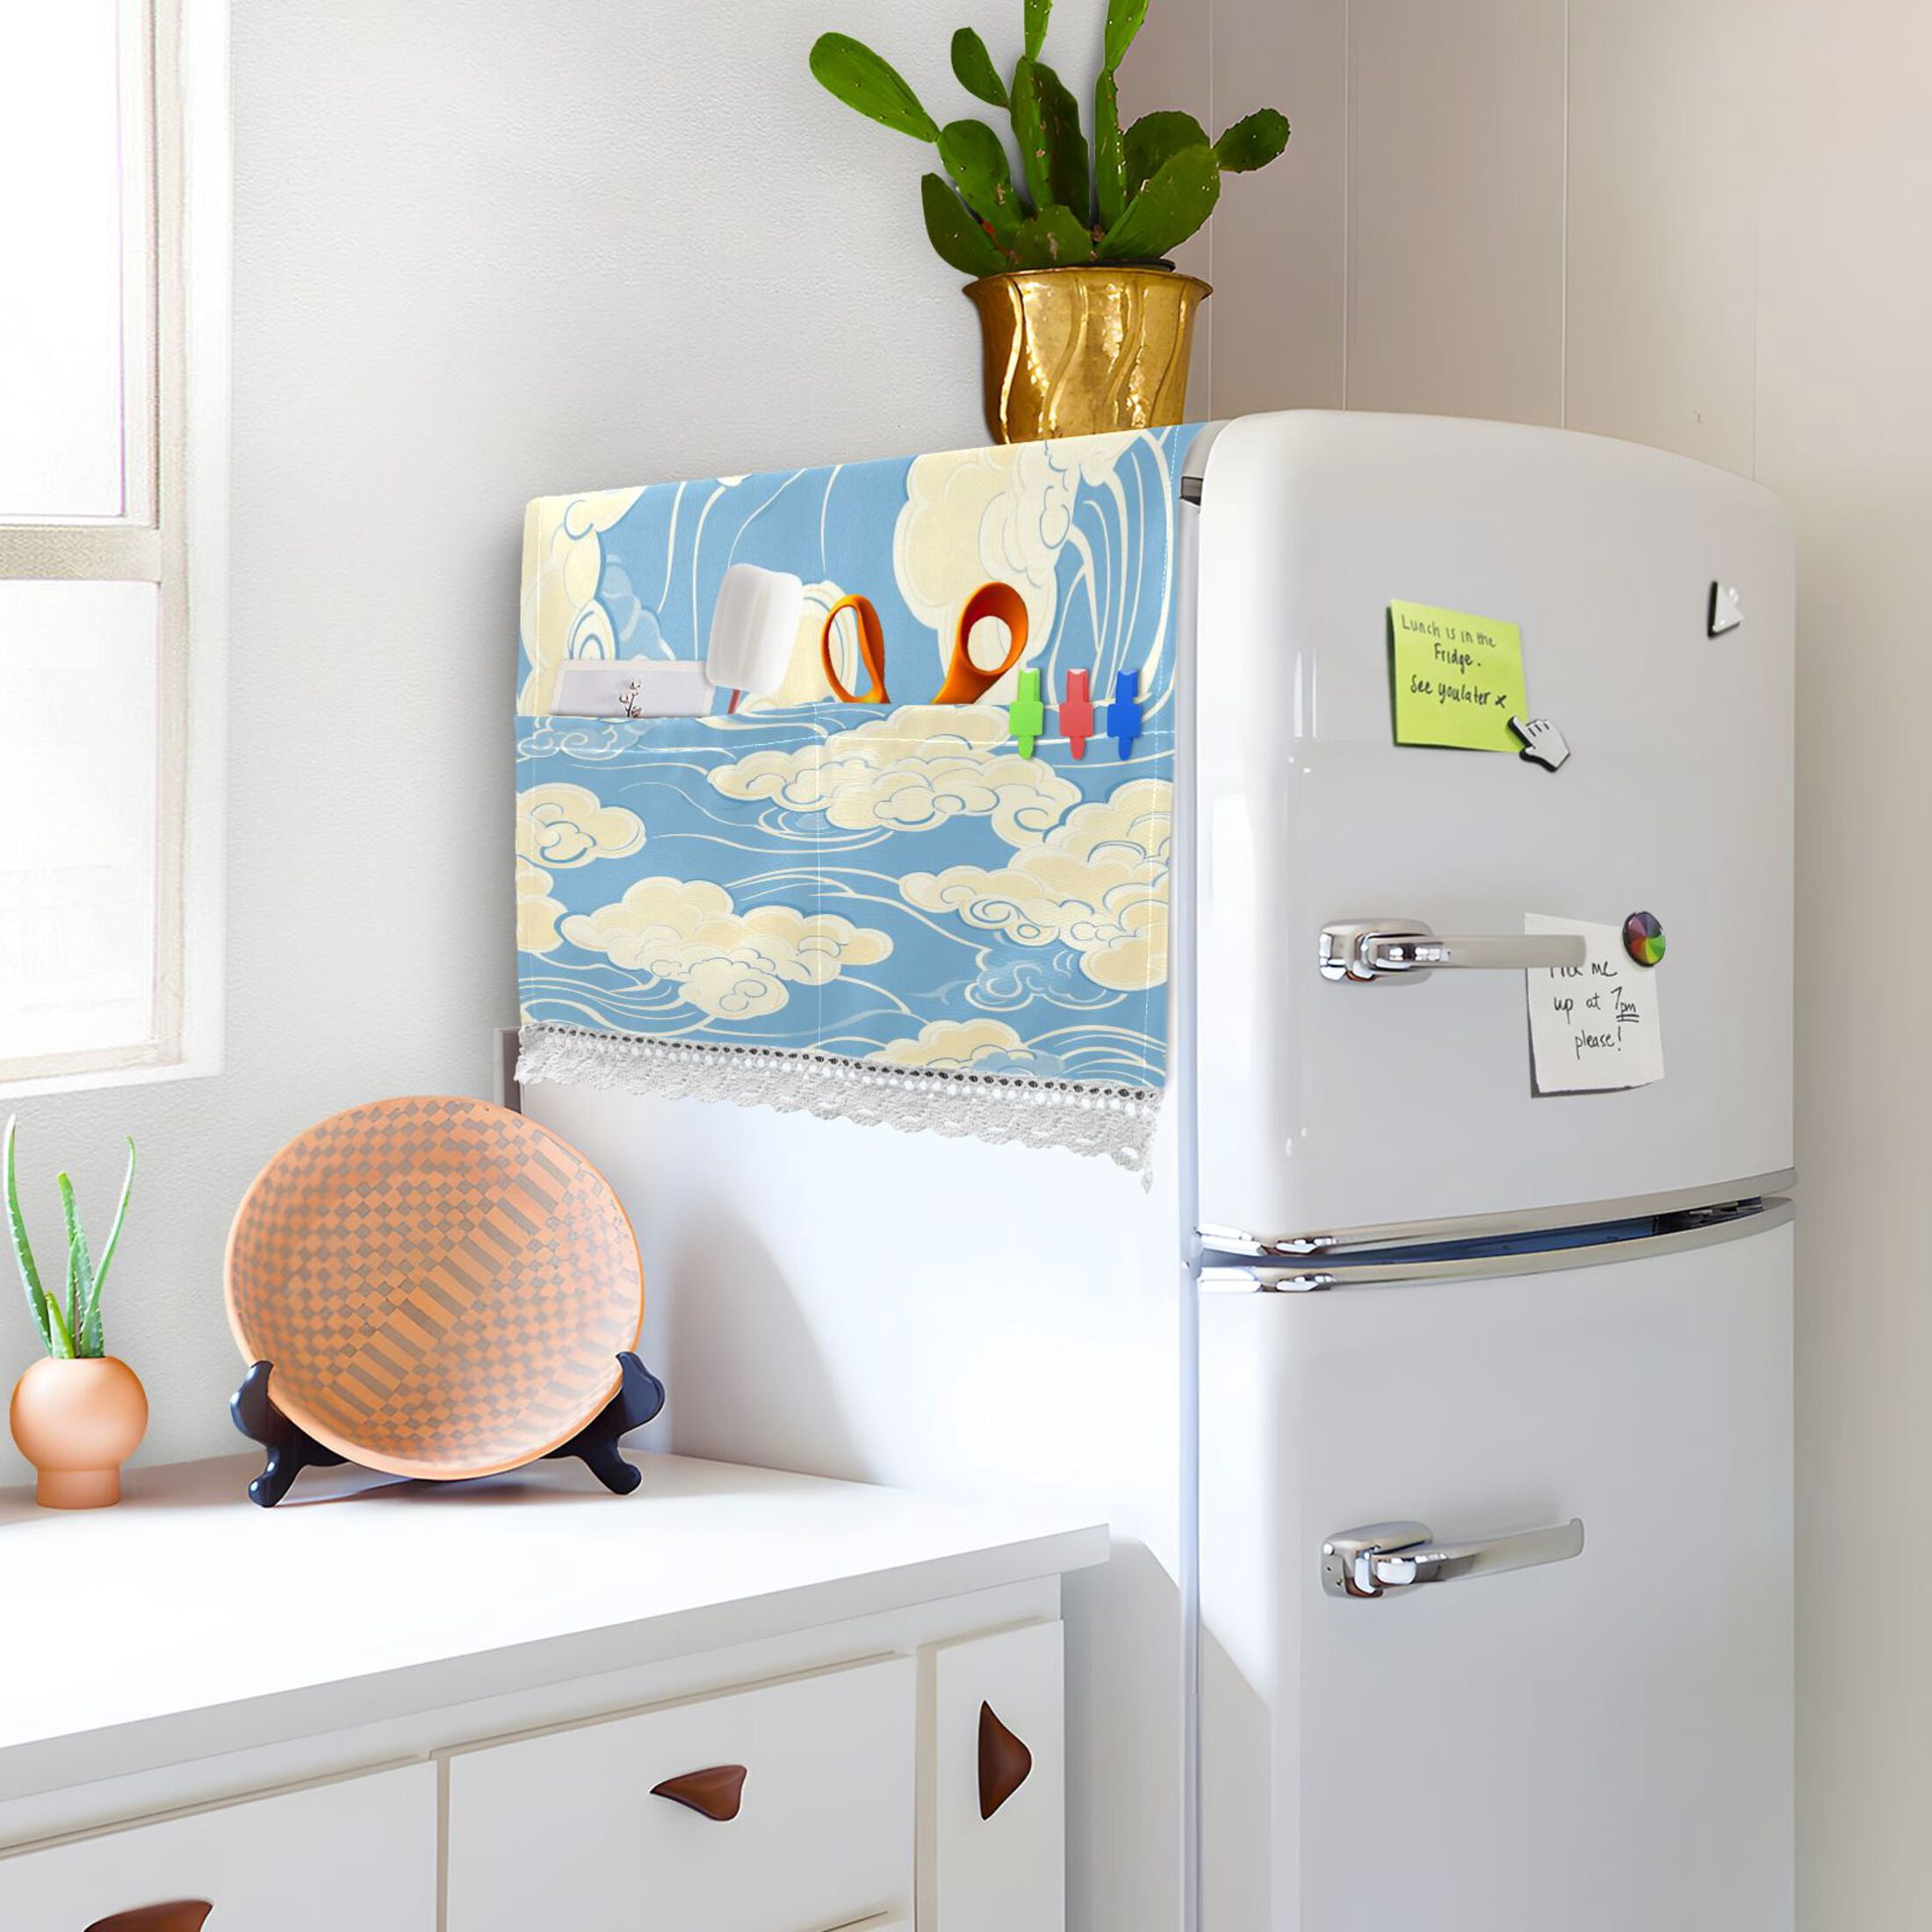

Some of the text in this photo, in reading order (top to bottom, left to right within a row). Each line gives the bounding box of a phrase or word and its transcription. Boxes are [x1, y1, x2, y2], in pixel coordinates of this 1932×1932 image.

[1402, 614, 1496, 648] Lunch is in the
[1410, 674, 1432, 694] See
[1591, 961, 1618, 977] me
[1554, 997, 1574, 1025] up
[1586, 991, 1601, 1011] at
[1575, 1026, 1622, 1060] please!
